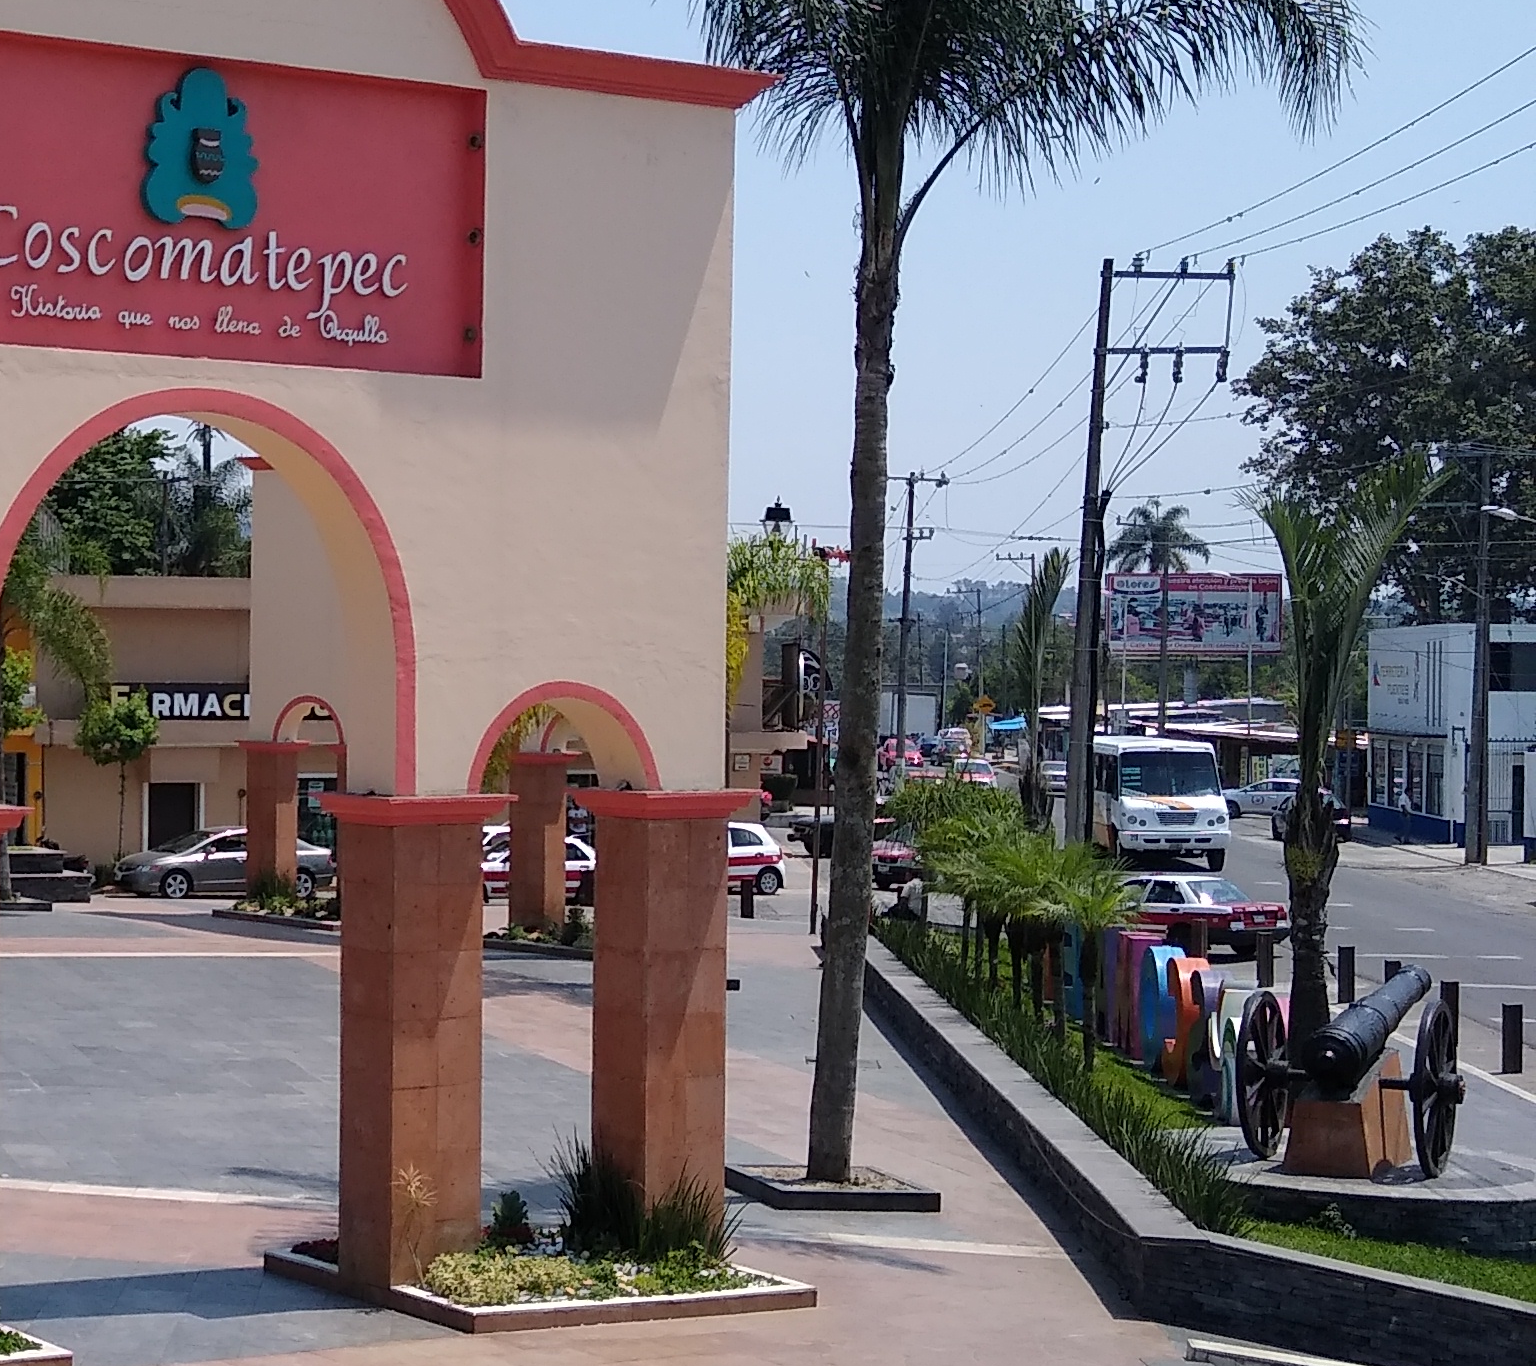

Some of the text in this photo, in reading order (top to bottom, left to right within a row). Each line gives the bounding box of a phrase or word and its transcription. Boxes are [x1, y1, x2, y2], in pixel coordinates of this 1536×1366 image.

[10, 283, 102, 321] Historia
[117, 309, 154, 330] que
[168, 314, 201, 331] nos
[214, 305, 262, 335] llena
[277, 315, 302, 338] de
[111, 685, 251, 718] FRMACI
